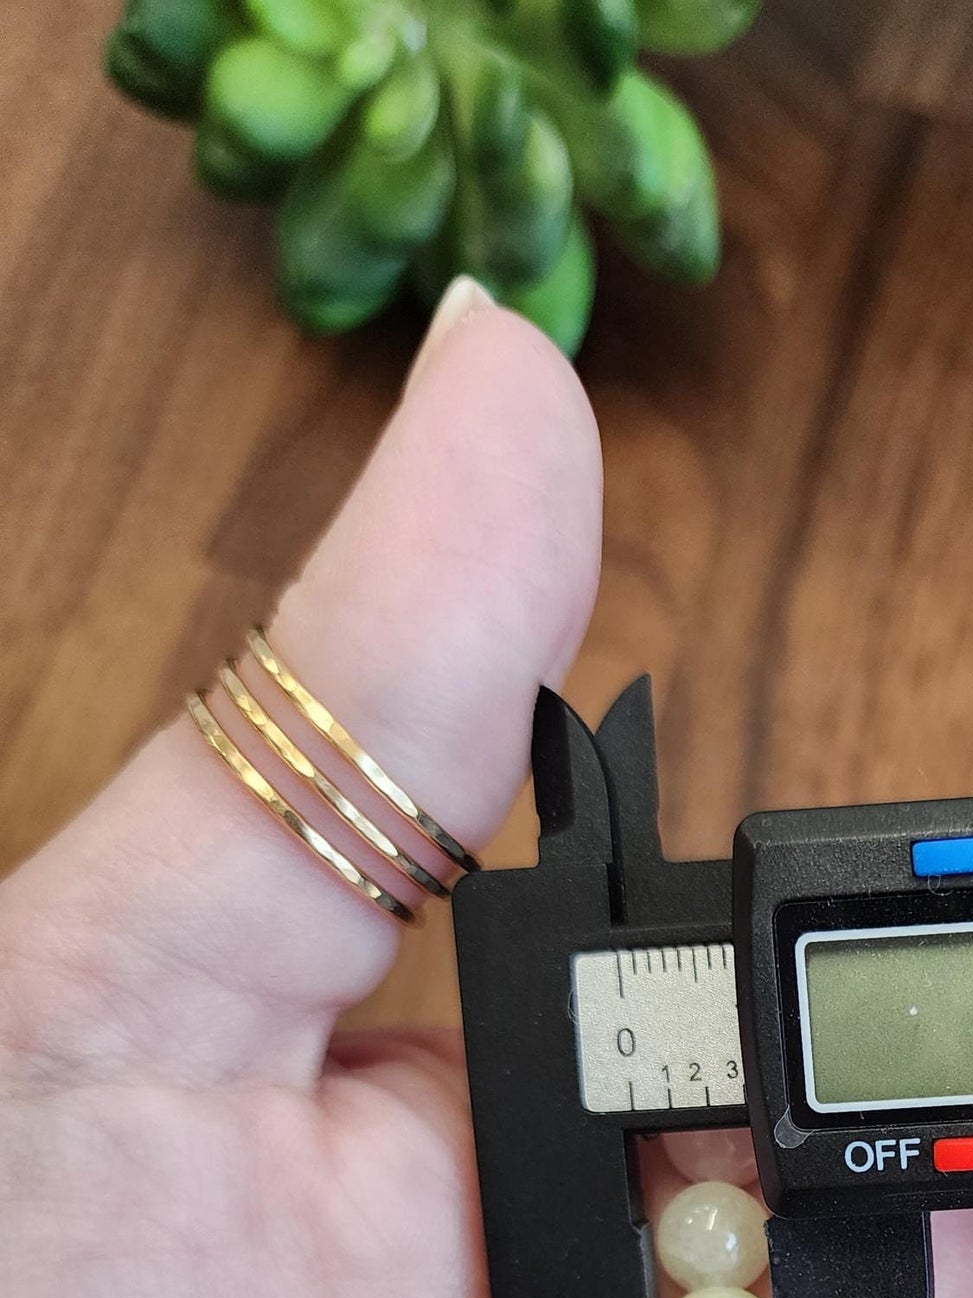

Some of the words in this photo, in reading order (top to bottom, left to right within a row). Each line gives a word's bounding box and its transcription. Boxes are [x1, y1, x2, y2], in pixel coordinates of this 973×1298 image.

[617, 1029, 635, 1056] 0
[662, 1066, 670, 1082] 1
[690, 1063, 701, 1081] 2
[727, 1061, 738, 1078] 3
[843, 1137, 922, 1176] OFF
